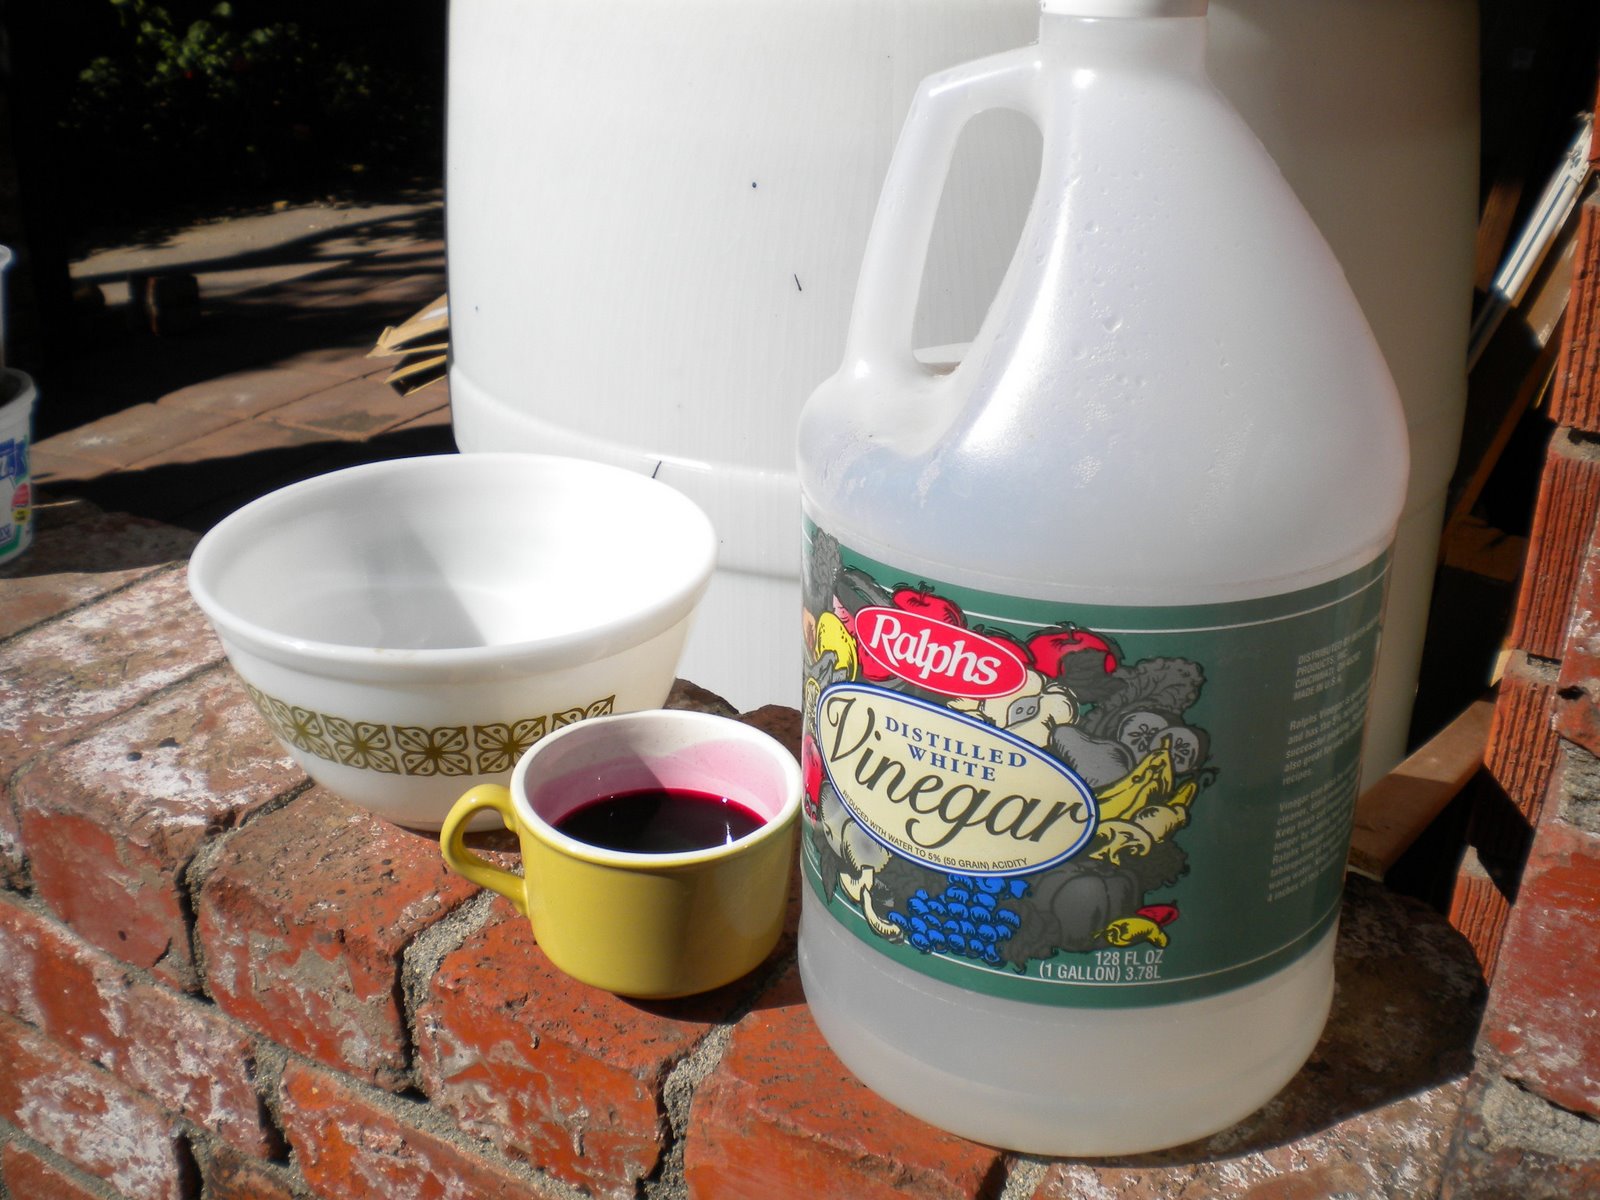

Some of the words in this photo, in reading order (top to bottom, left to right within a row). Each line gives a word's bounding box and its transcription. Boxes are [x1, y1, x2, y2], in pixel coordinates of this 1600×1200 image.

[869, 614, 1001, 686] Ralphs
[885, 716, 1027, 768] DISTILLED
[907, 743, 996, 782] WHITE
[827, 697, 1094, 848] Vinegar
[842, 789, 869, 823] REDUCED
[869, 820, 887, 838] WITH
[888, 832, 913, 852] WATER
[915, 846, 926, 858] TO
[928, 852, 941, 863] 5%
[943, 856, 956, 867] (50
[958, 859, 990, 871] GRAIN)
[992, 857, 1028, 870] ACIDITY
[1039, 961, 1052, 979] (1
[1057, 964, 1121, 984] GALLON)
[1125, 964, 1161, 981] 3.78L
[1095, 951, 1120, 966] 128
[1124, 950, 1140, 966] FL
[1145, 949, 1164, 965] OZ
